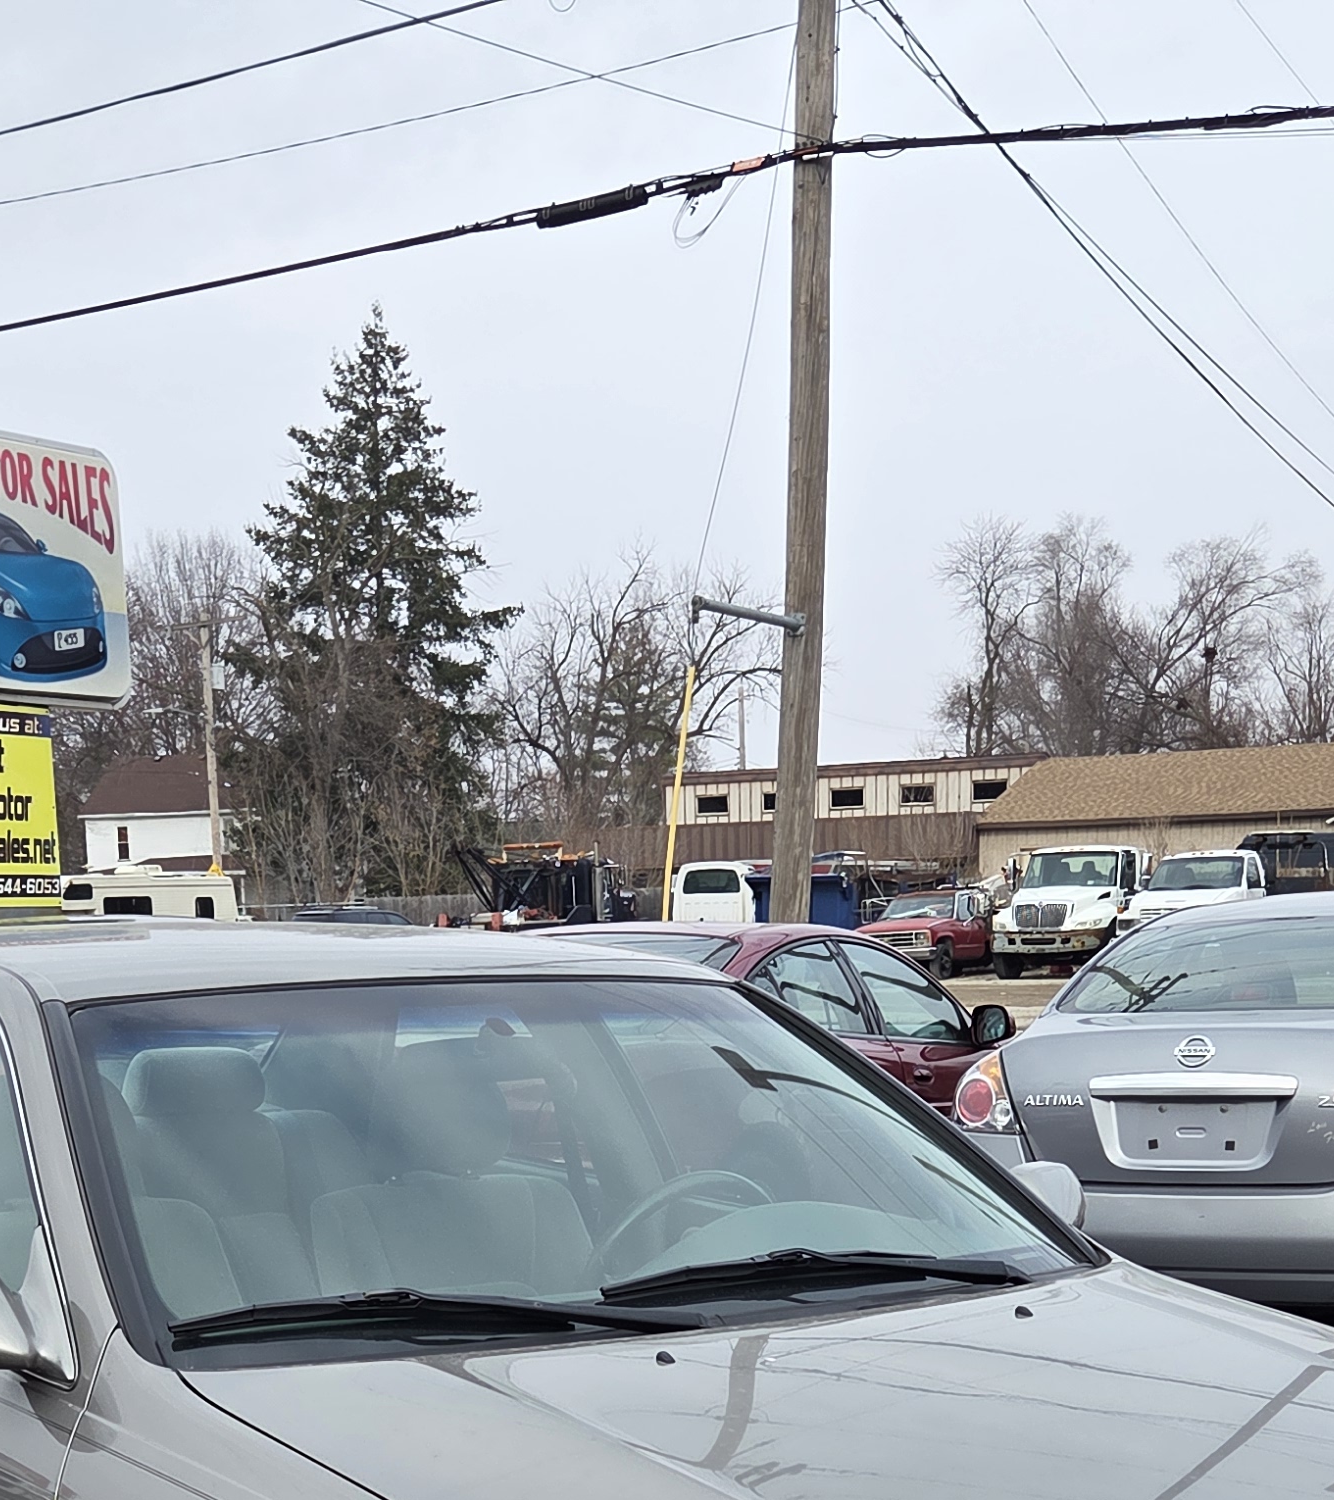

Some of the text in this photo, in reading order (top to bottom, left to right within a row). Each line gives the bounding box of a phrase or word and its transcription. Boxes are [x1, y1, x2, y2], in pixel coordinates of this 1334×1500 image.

[41, 456, 114, 555] SALES
[24, 718, 43, 735] at:
[1023, 1094, 1085, 1107] ALTIMA
